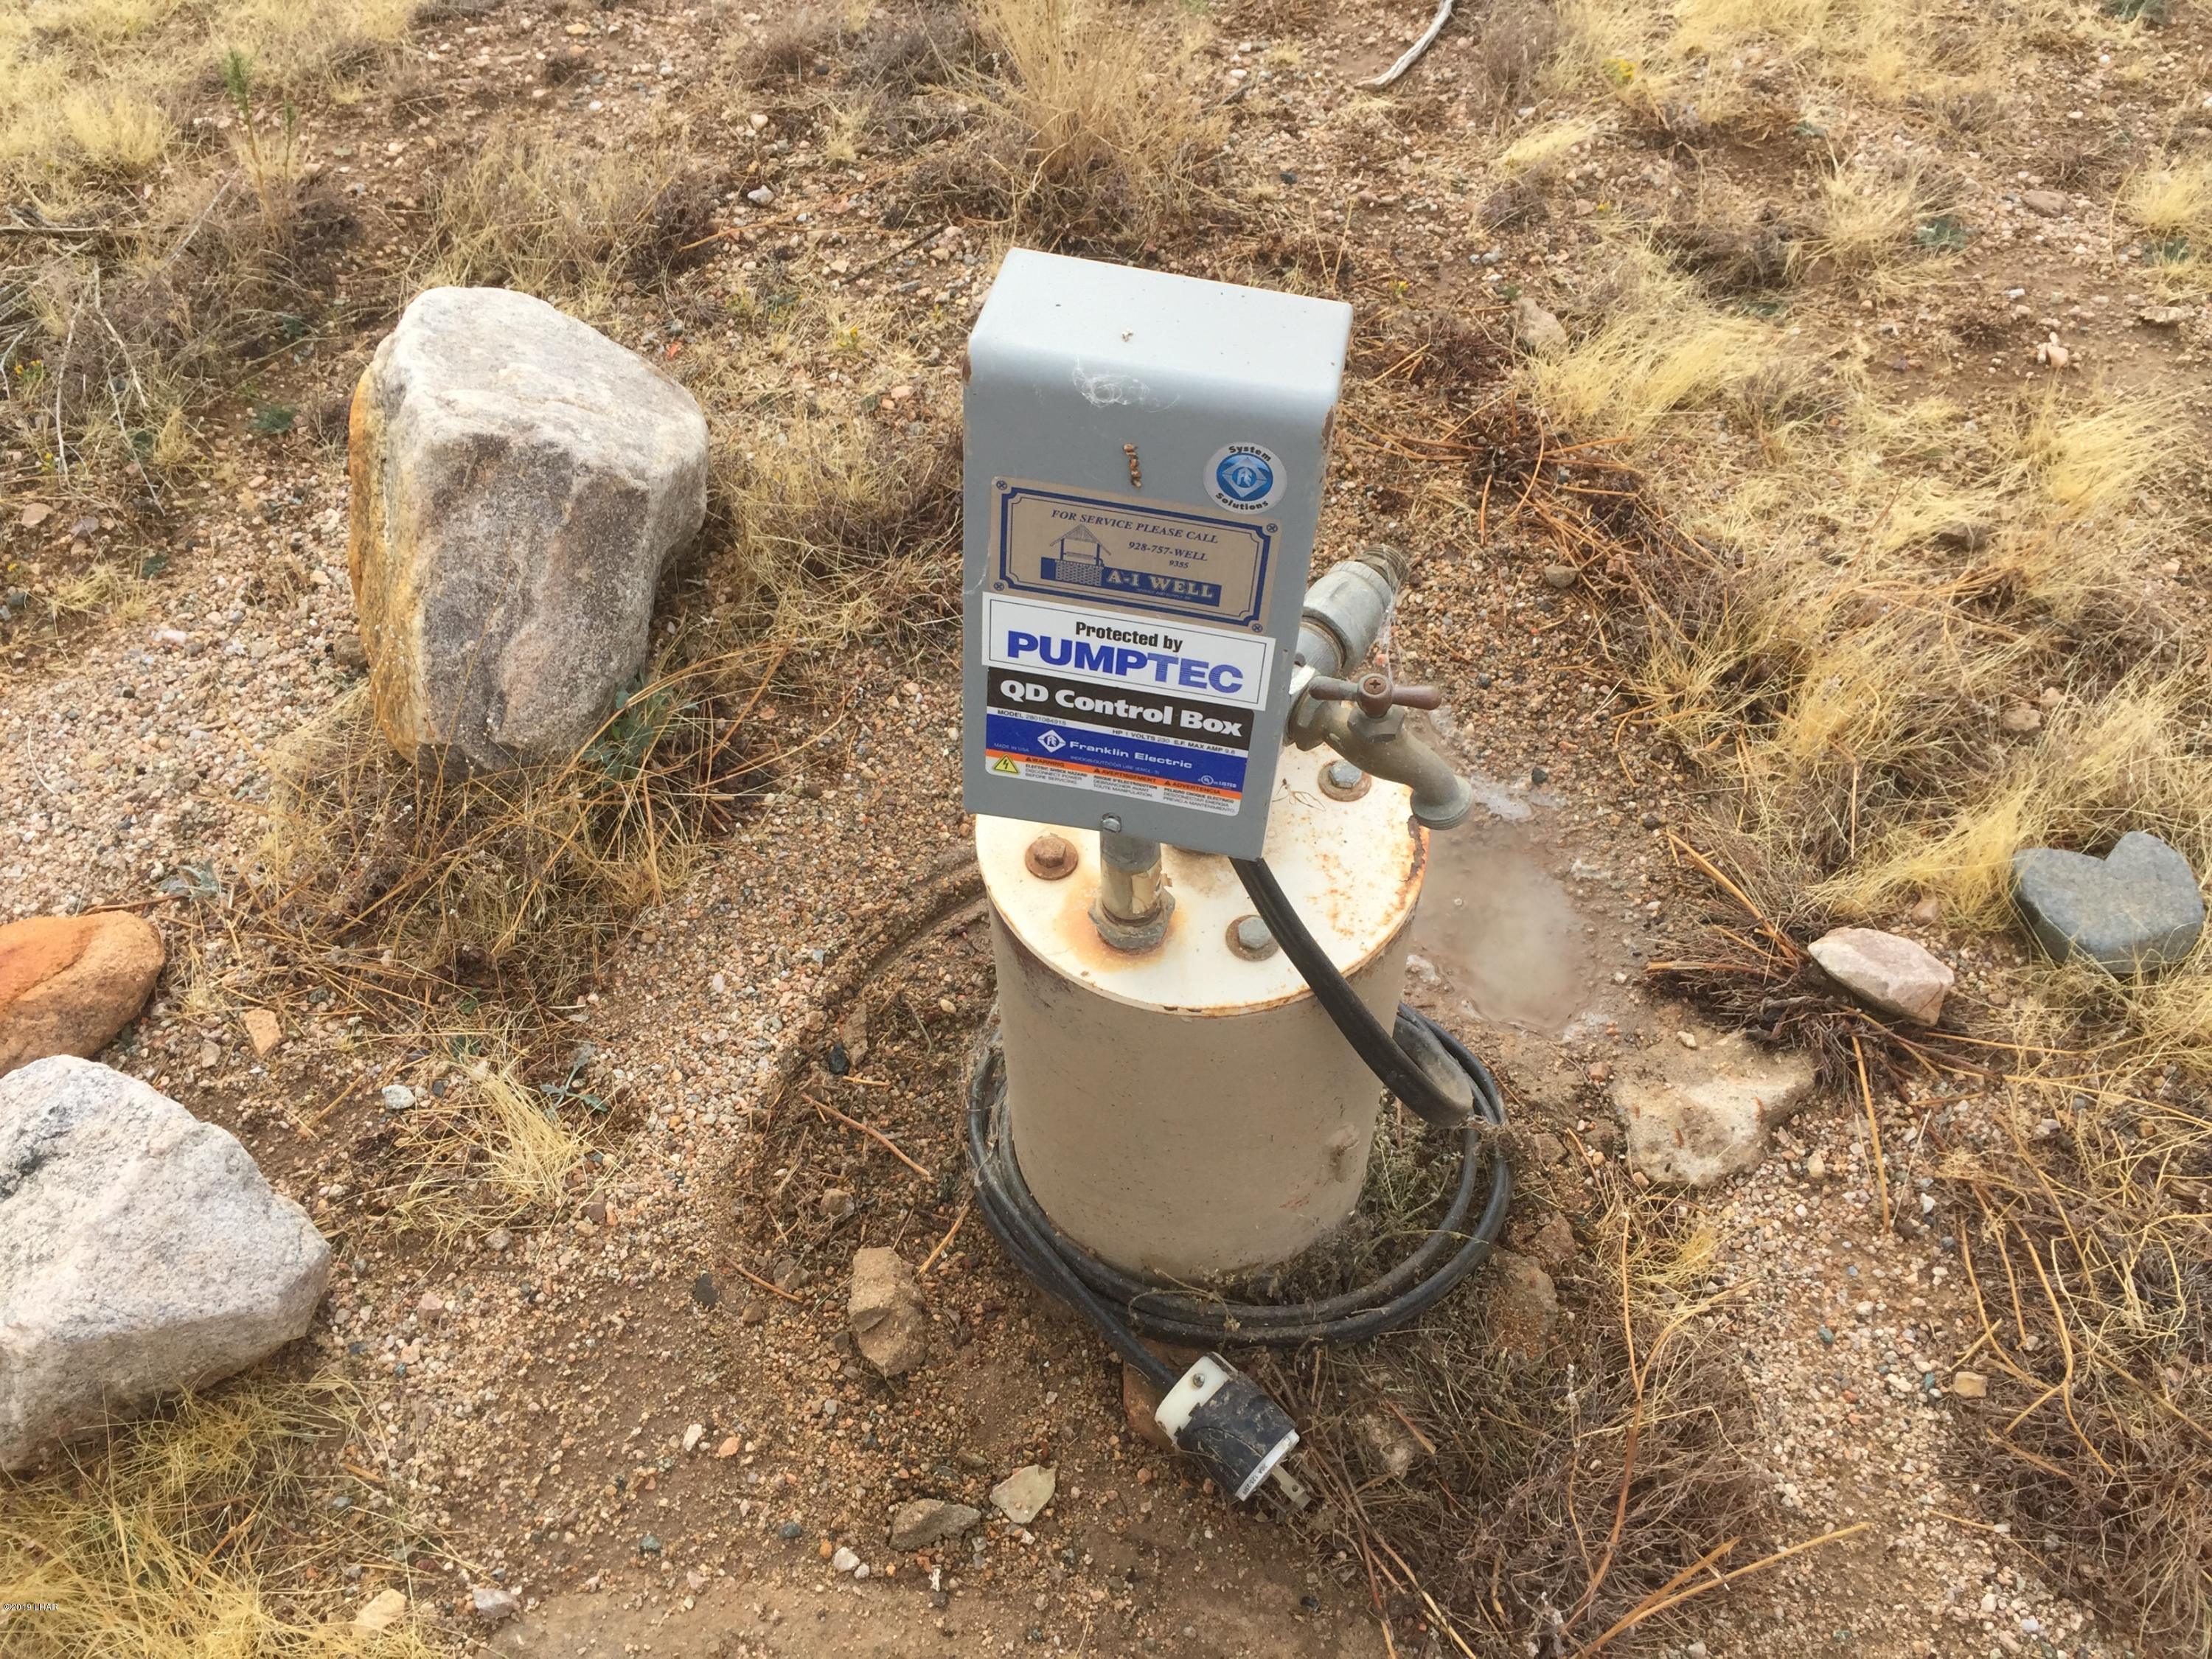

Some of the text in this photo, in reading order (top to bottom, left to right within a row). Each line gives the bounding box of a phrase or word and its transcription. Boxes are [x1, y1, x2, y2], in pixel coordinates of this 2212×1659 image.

[1228, 445, 1271, 462] System
[1215, 493, 1269, 510] Solutions
[1051, 509, 1219, 543] FOR SERVICE PLEASE CALL
[1128, 541, 1208, 561] 928-757-WELL
[1169, 560, 1189, 569] 9355
[1149, 576, 1213, 598] WELL
[1075, 621, 1183, 653] Protected by
[1007, 630, 1244, 694] PUMPTEC
[997, 709, 1024, 719] MODEL
[1000, 679, 1245, 737] QD Control Box
[1130, 732, 1155, 742] VOLTS
[1206, 745, 1223, 753] AMP
[1032, 757, 1065, 768] WARNING
[1069, 740, 1193, 769] Franklin Electric
[1172, 781, 1221, 795] ADVERTENCIA
